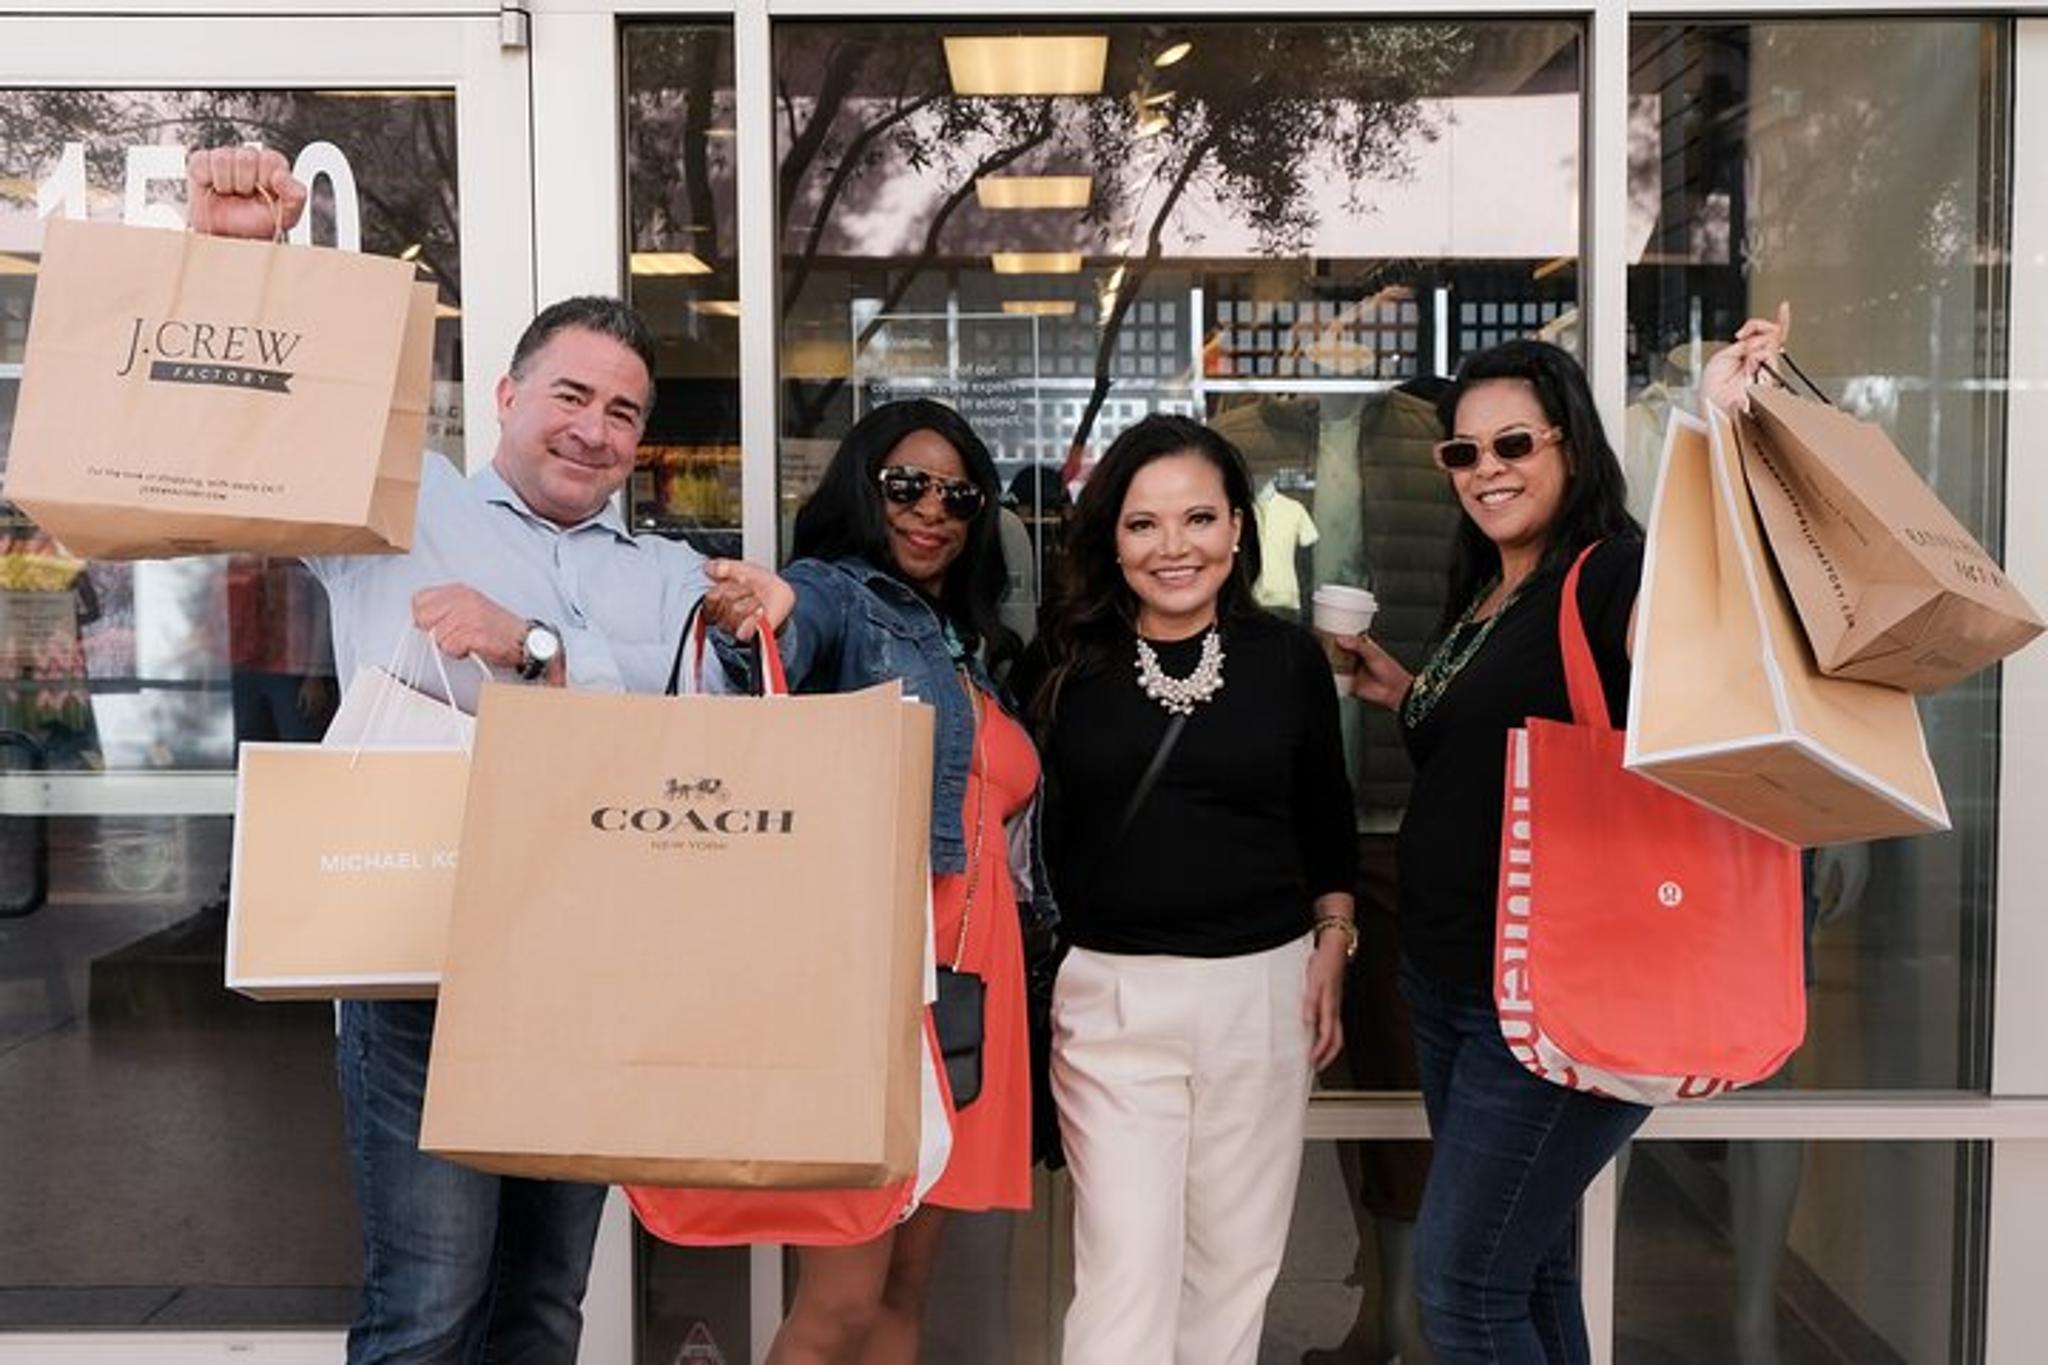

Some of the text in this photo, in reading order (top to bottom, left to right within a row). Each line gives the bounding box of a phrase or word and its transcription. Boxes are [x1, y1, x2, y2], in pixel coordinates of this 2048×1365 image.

[117, 317, 302, 377] J.CREW
[173, 366, 269, 384] FACTORY
[591, 807, 795, 834] COACH
[651, 840, 728, 850] NEW YORK
[320, 851, 424, 873] MICHAEL
